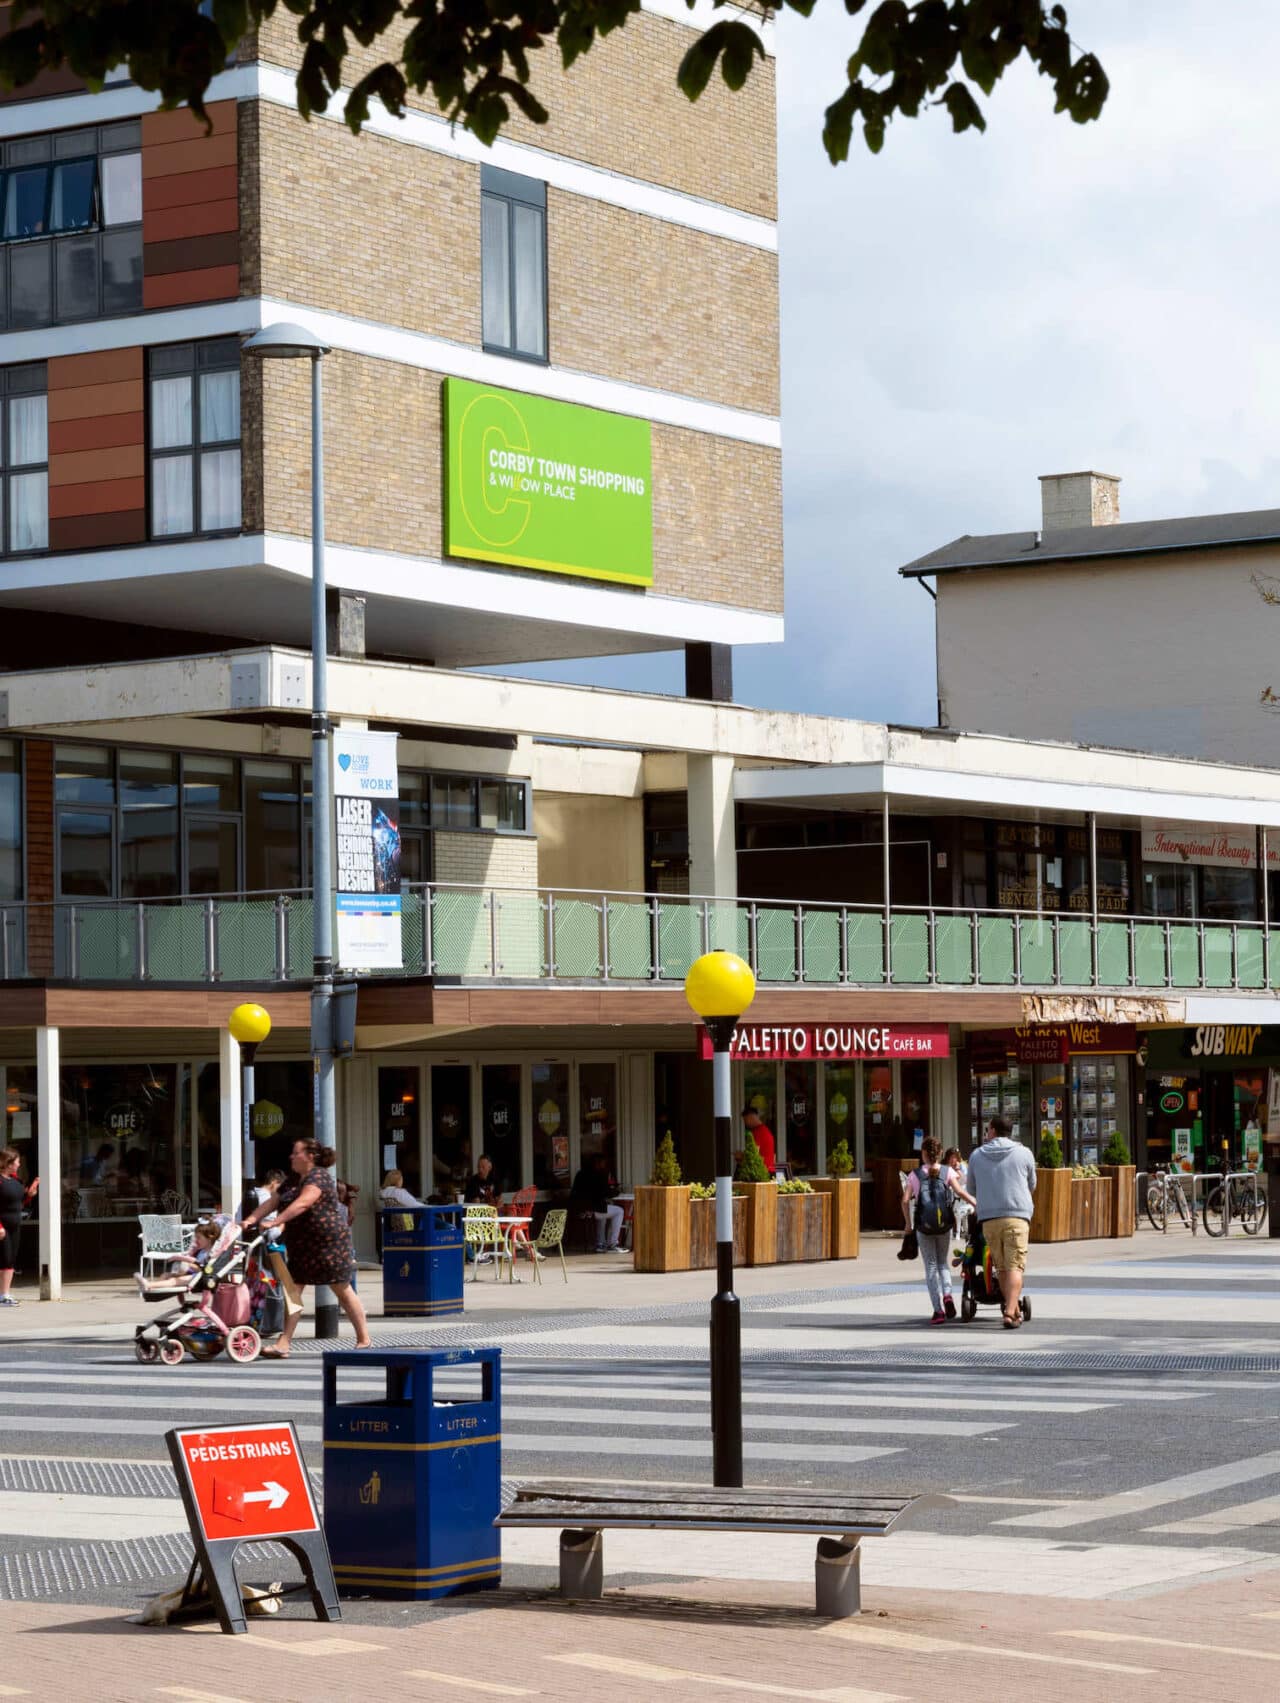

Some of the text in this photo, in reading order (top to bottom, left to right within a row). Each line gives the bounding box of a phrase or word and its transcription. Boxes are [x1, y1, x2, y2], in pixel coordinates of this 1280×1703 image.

[489, 448, 645, 497] CORBY TOWN SHOPPING
[489, 472, 497, 486] &
[543, 482, 576, 501] PLACE
[360, 778, 393, 790] WORK
[336, 797, 373, 825] LASER
[1218, 837, 1251, 865] Beauty
[338, 869, 376, 892] DESIGN
[999, 893, 1061, 907] RENEGDE
[815, 1028, 890, 1051] LOUNGE
[893, 1037, 914, 1051] CAFÉ
[916, 1039, 932, 1050] BAR
[1070, 1023, 1101, 1044] West
[1191, 1025, 1262, 1056] SUBWAY
[1021, 1040, 1058, 1049] PALETTO
[1021, 1050, 1058, 1060] LOUNGE
[111, 1111, 136, 1128] CAFÉ
[267, 1112, 284, 1126] BAR
[493, 1107, 509, 1124] CAFÉ
[350, 1420, 389, 1432] LITTER
[447, 1417, 478, 1431] LITTER
[188, 1439, 292, 1463] PEDESTRIANS
